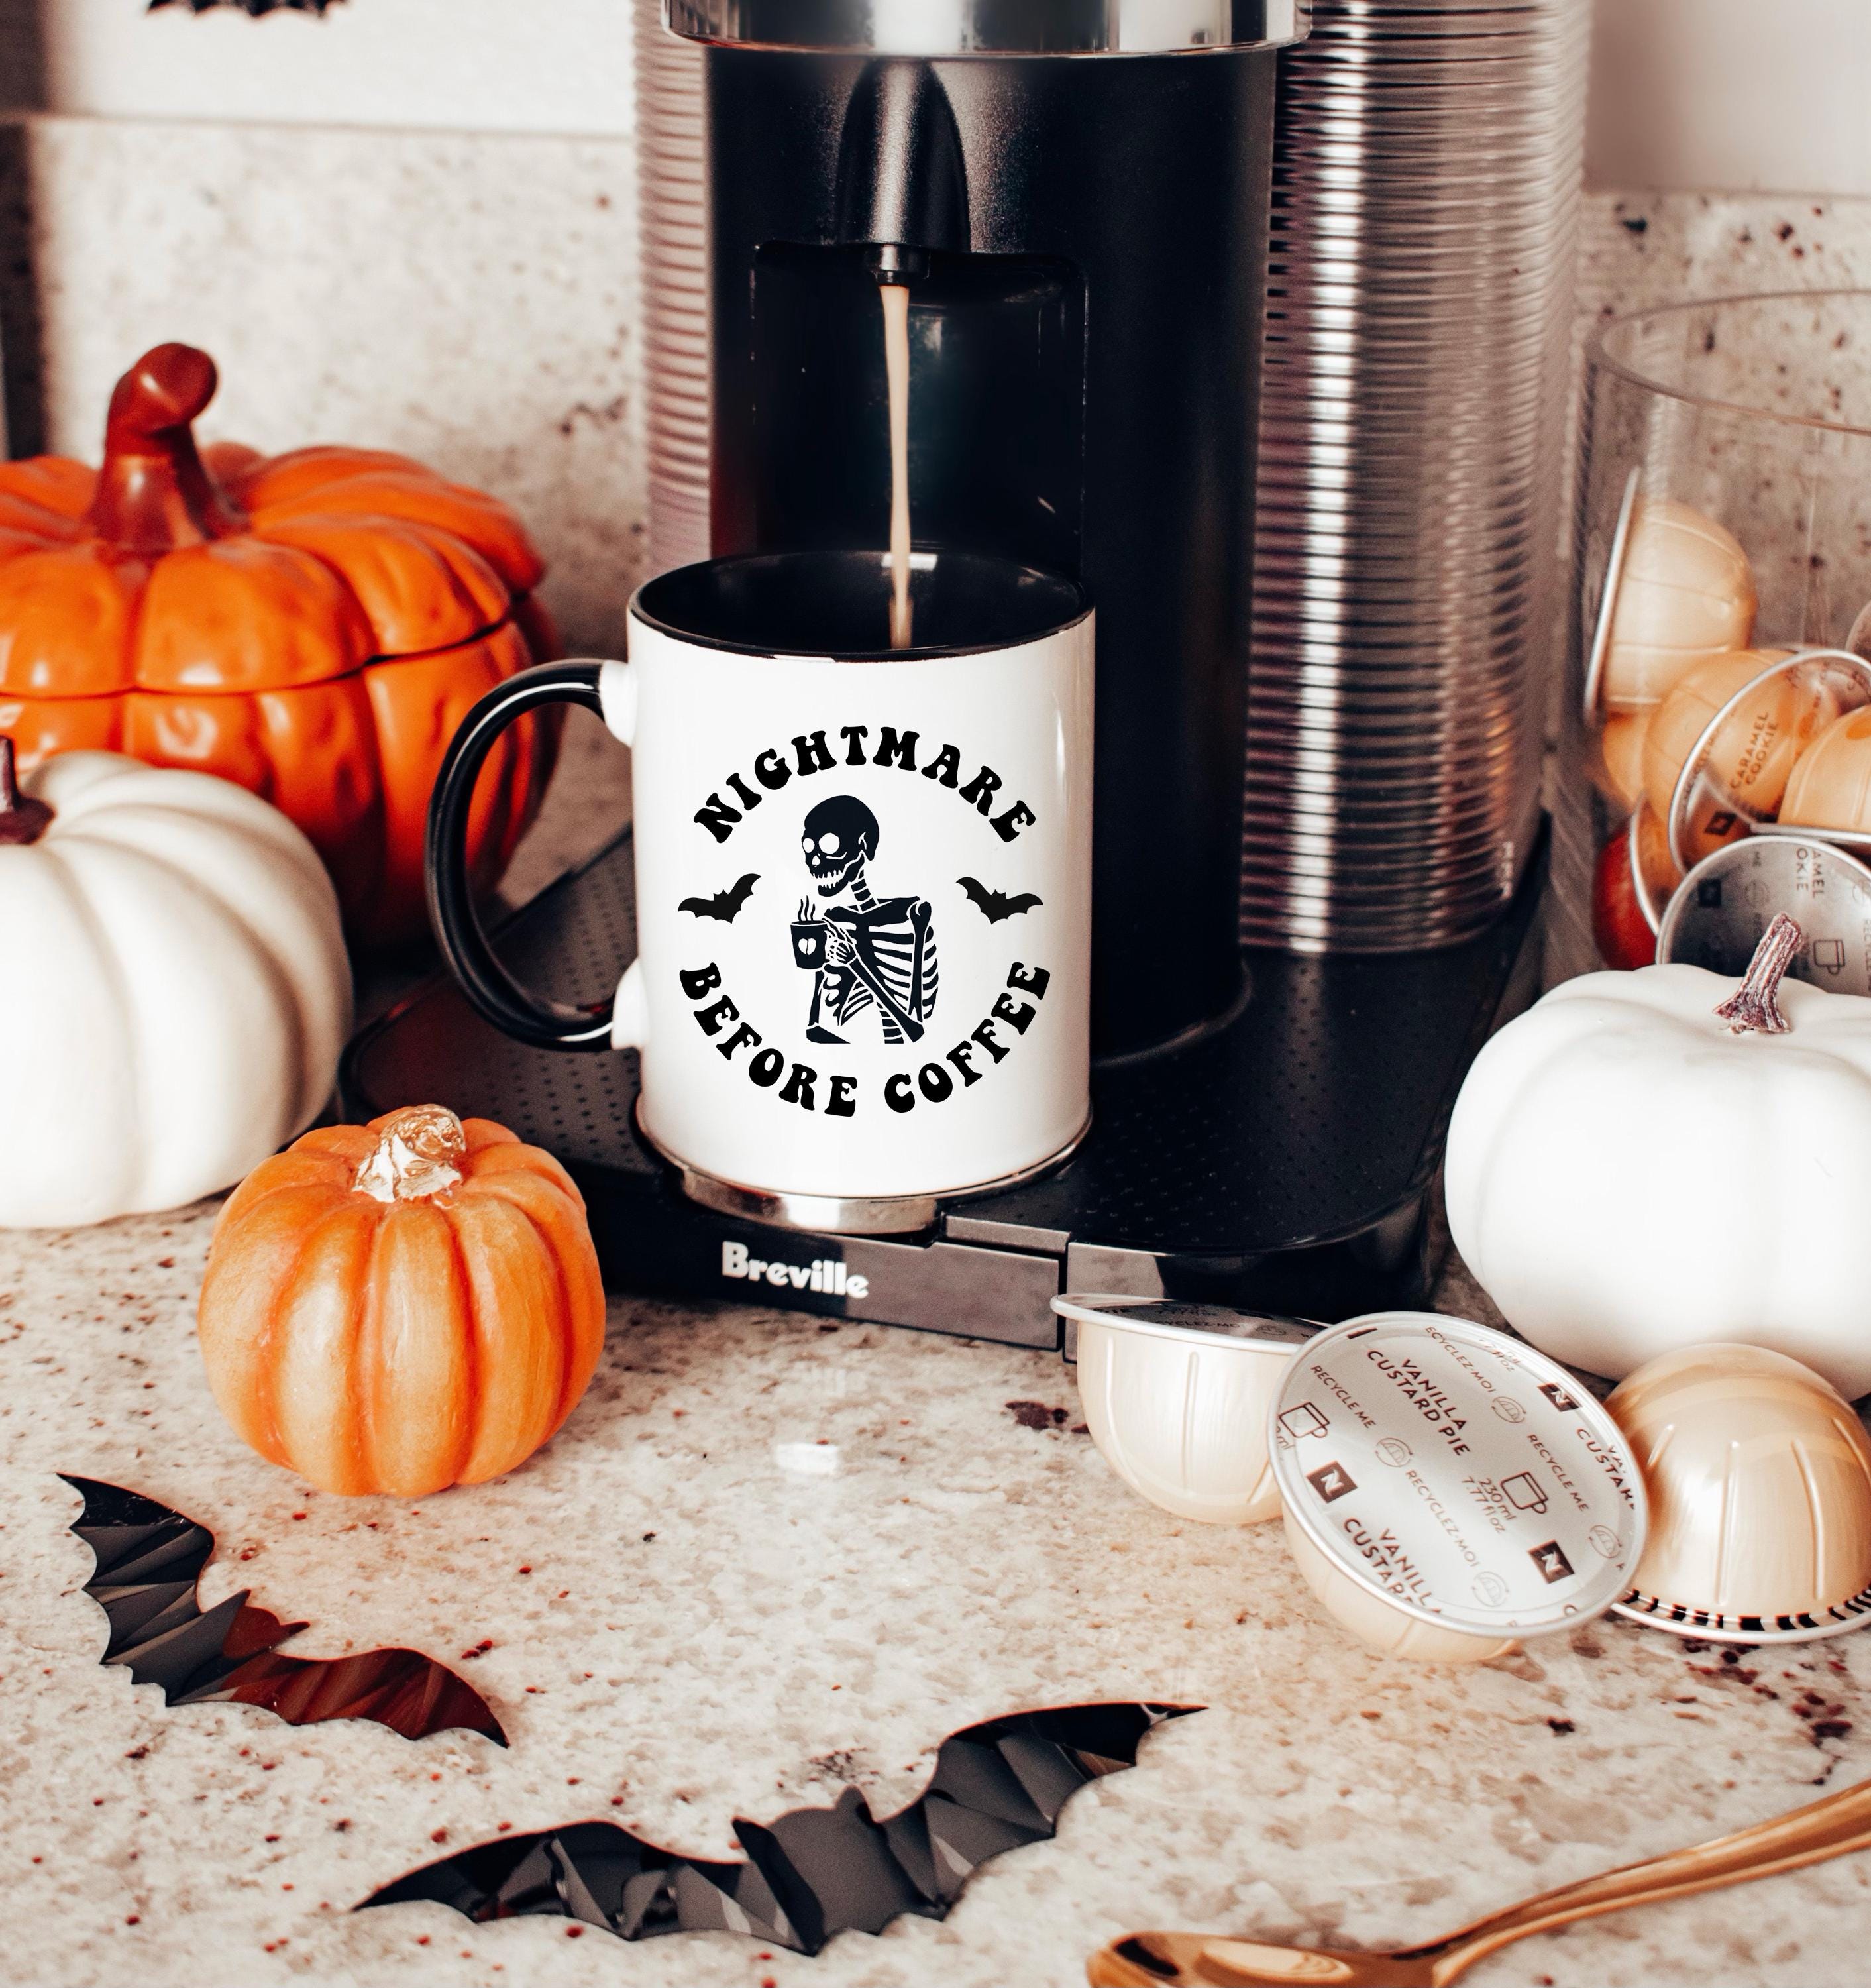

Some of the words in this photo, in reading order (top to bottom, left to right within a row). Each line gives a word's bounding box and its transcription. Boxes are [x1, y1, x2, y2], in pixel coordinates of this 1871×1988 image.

[694, 725, 1036, 843] NIGHTMARE
[1730, 712, 1768, 789] CARAMEL
[1745, 722, 1778, 785] COOKIE
[679, 962, 857, 1117] BEFORE
[884, 962, 1050, 1113] COFFEE
[722, 1241, 869, 1299] Breville
[1311, 1365, 1359, 1410] RECYCLE
[1354, 1411, 1376, 1429] ME
[1367, 1351, 1440, 1422] CUSTARD
[1438, 1425, 1471, 1456] PIE
[1402, 1359, 1467, 1430] VANILLA
[1462, 1476, 1488, 1503] 7.77
[1482, 1506, 1496, 1516] fl
[1490, 1518, 1506, 1534] oz
[1478, 1478, 1503, 1503] 230
[1498, 1504, 1517, 1521] ml
[1527, 1434, 1574, 1489] RECYCLE
[1570, 1491, 1589, 1512] ME
[1405, 1470, 1479, 1567] RECYCLEZ-MOI
